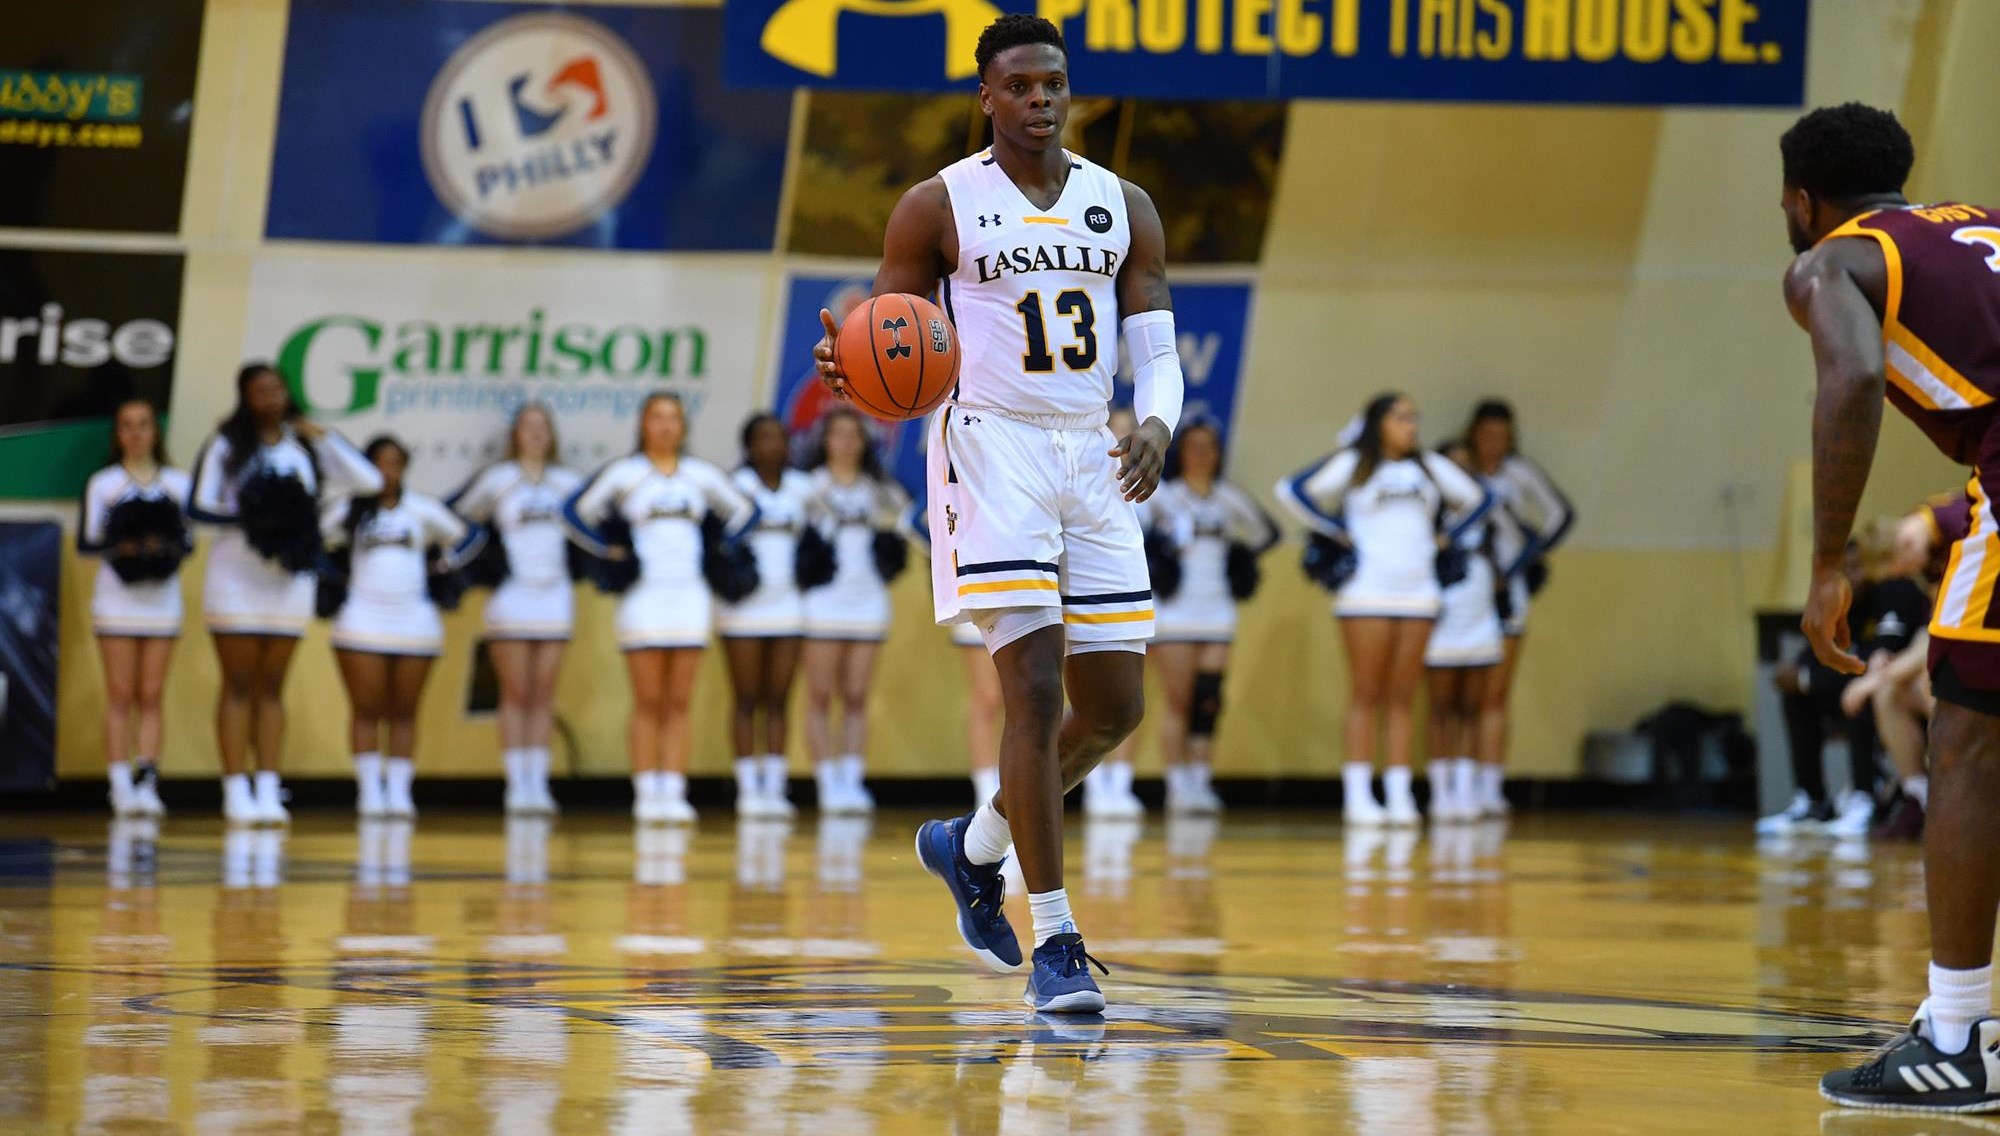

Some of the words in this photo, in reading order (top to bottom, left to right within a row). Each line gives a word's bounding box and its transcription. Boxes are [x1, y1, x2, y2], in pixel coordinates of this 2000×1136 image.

[1089, 213, 1108, 225] RB
[929, 319, 945, 353] 695
[1015, 287, 1098, 373] 13
[277, 307, 708, 420] Garrison
